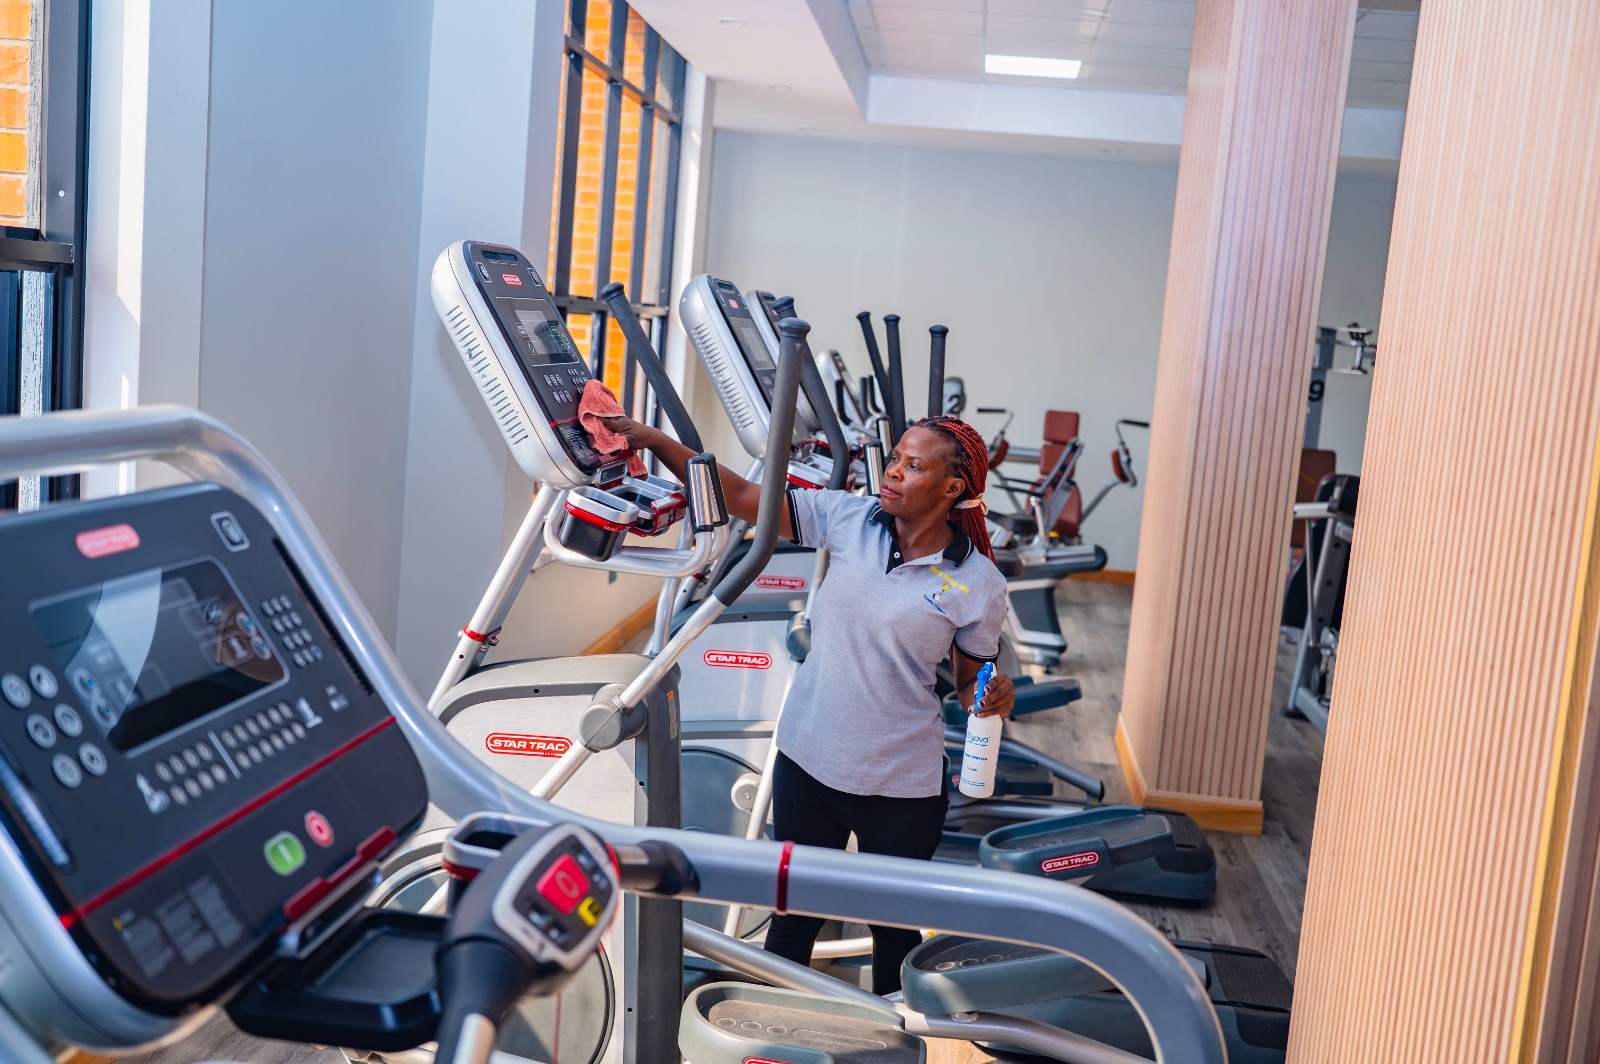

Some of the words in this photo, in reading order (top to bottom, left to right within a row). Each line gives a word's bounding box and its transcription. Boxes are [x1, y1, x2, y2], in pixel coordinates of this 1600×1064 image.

[1308, 380, 1325, 401] 9
[948, 394, 960, 414] 2
[709, 654, 737, 663] STAR
[737, 655, 767, 665] TRAC
[493, 739, 527, 749] STAR
[529, 741, 566, 752] TRAC
[1045, 859, 1069, 869] STAR
[1070, 855, 1095, 865] TRAC
